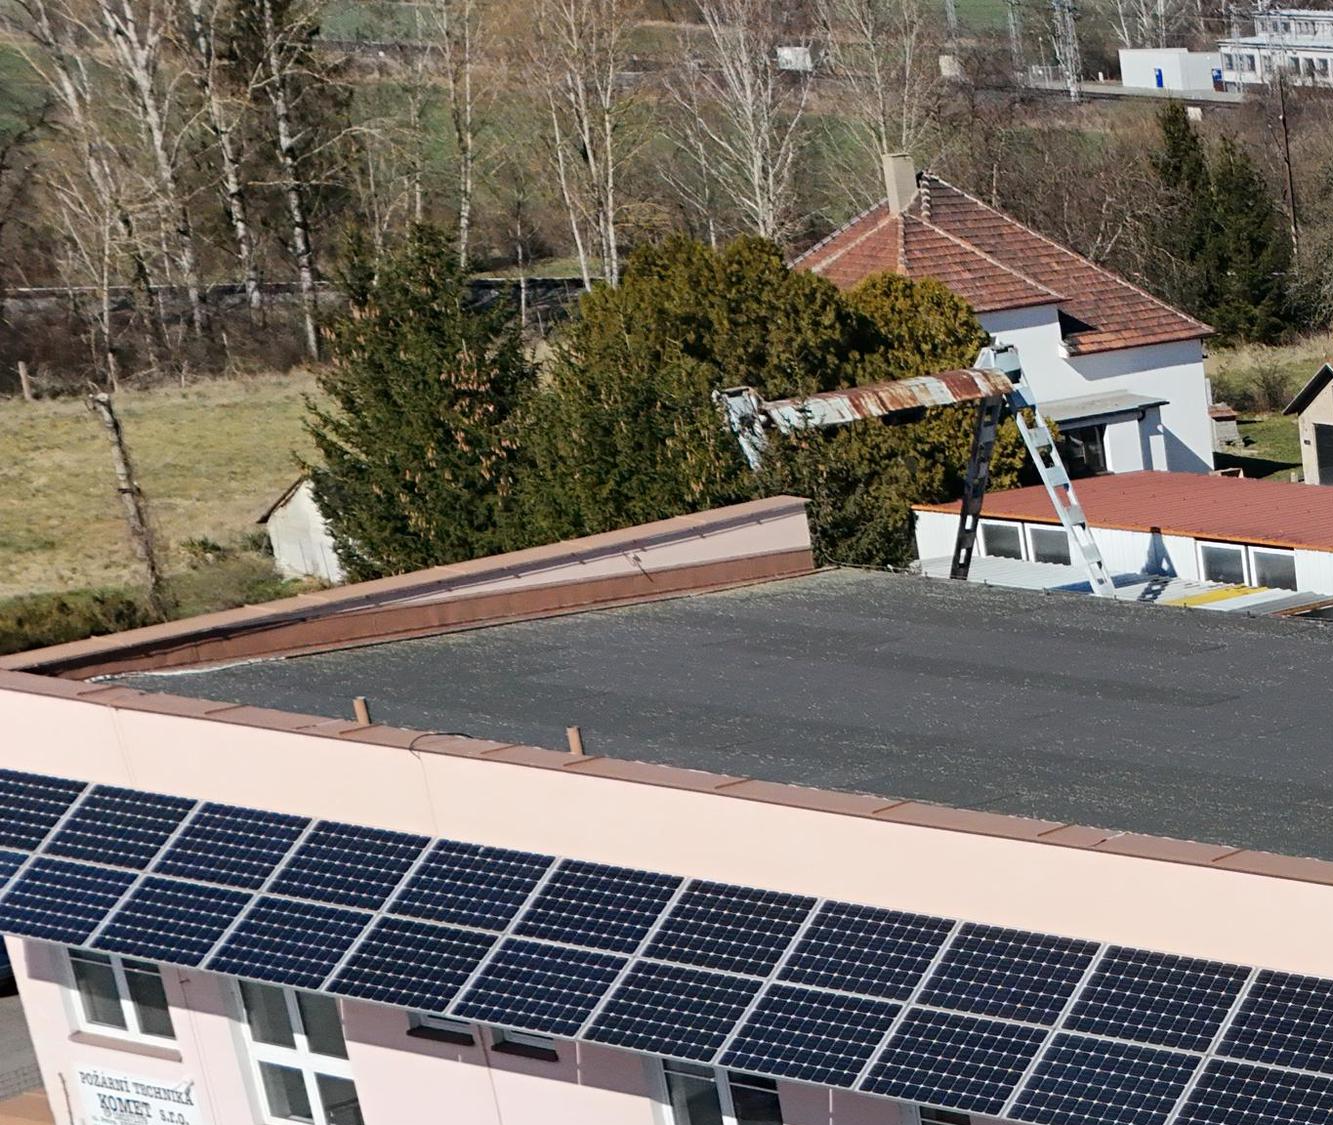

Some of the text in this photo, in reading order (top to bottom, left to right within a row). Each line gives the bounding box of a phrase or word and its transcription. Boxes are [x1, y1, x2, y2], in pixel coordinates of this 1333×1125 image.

[79, 1069, 195, 1106] POŽÁRNÍ TECHNIKA
[97, 1092, 152, 1119] KOMET
